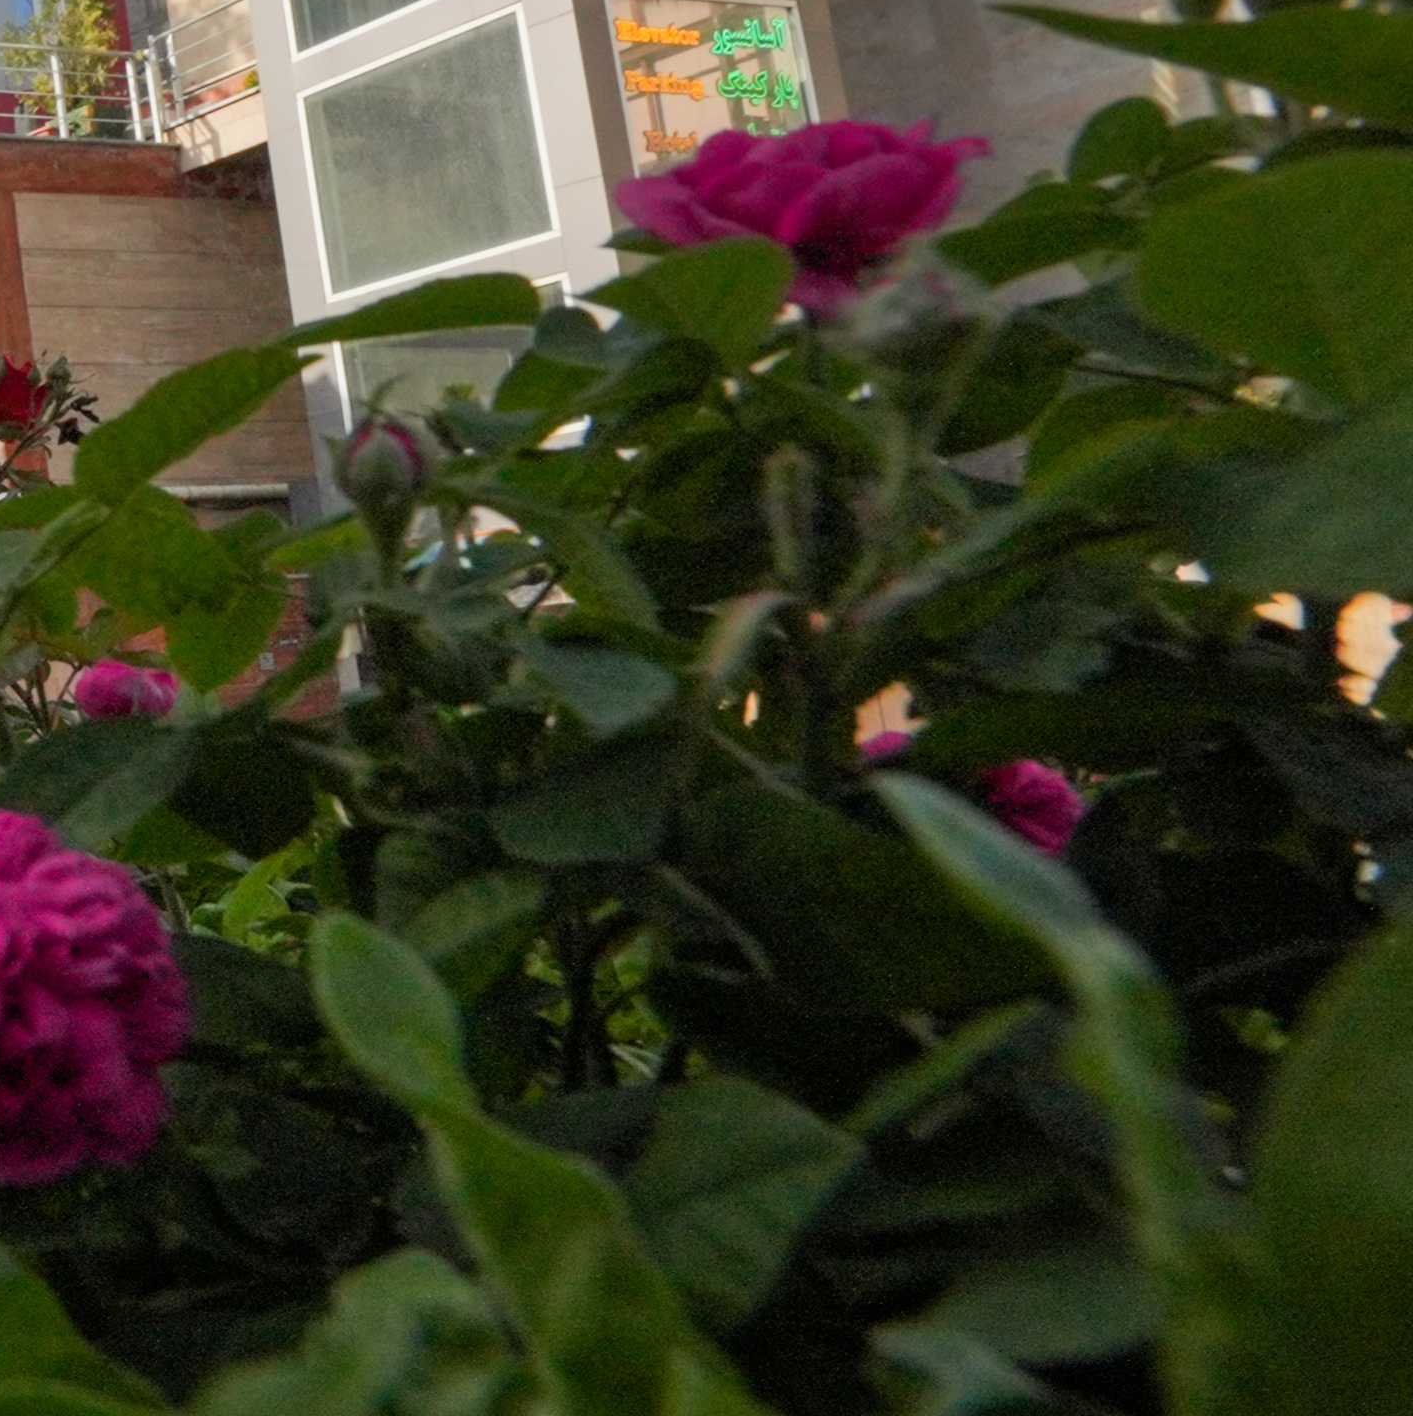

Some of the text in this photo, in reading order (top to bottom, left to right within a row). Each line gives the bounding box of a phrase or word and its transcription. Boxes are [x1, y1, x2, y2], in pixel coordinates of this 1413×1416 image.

[614, 18, 701, 46] Elevator
[710, 18, 787, 55] آسانسور
[624, 69, 706, 101] Parking
